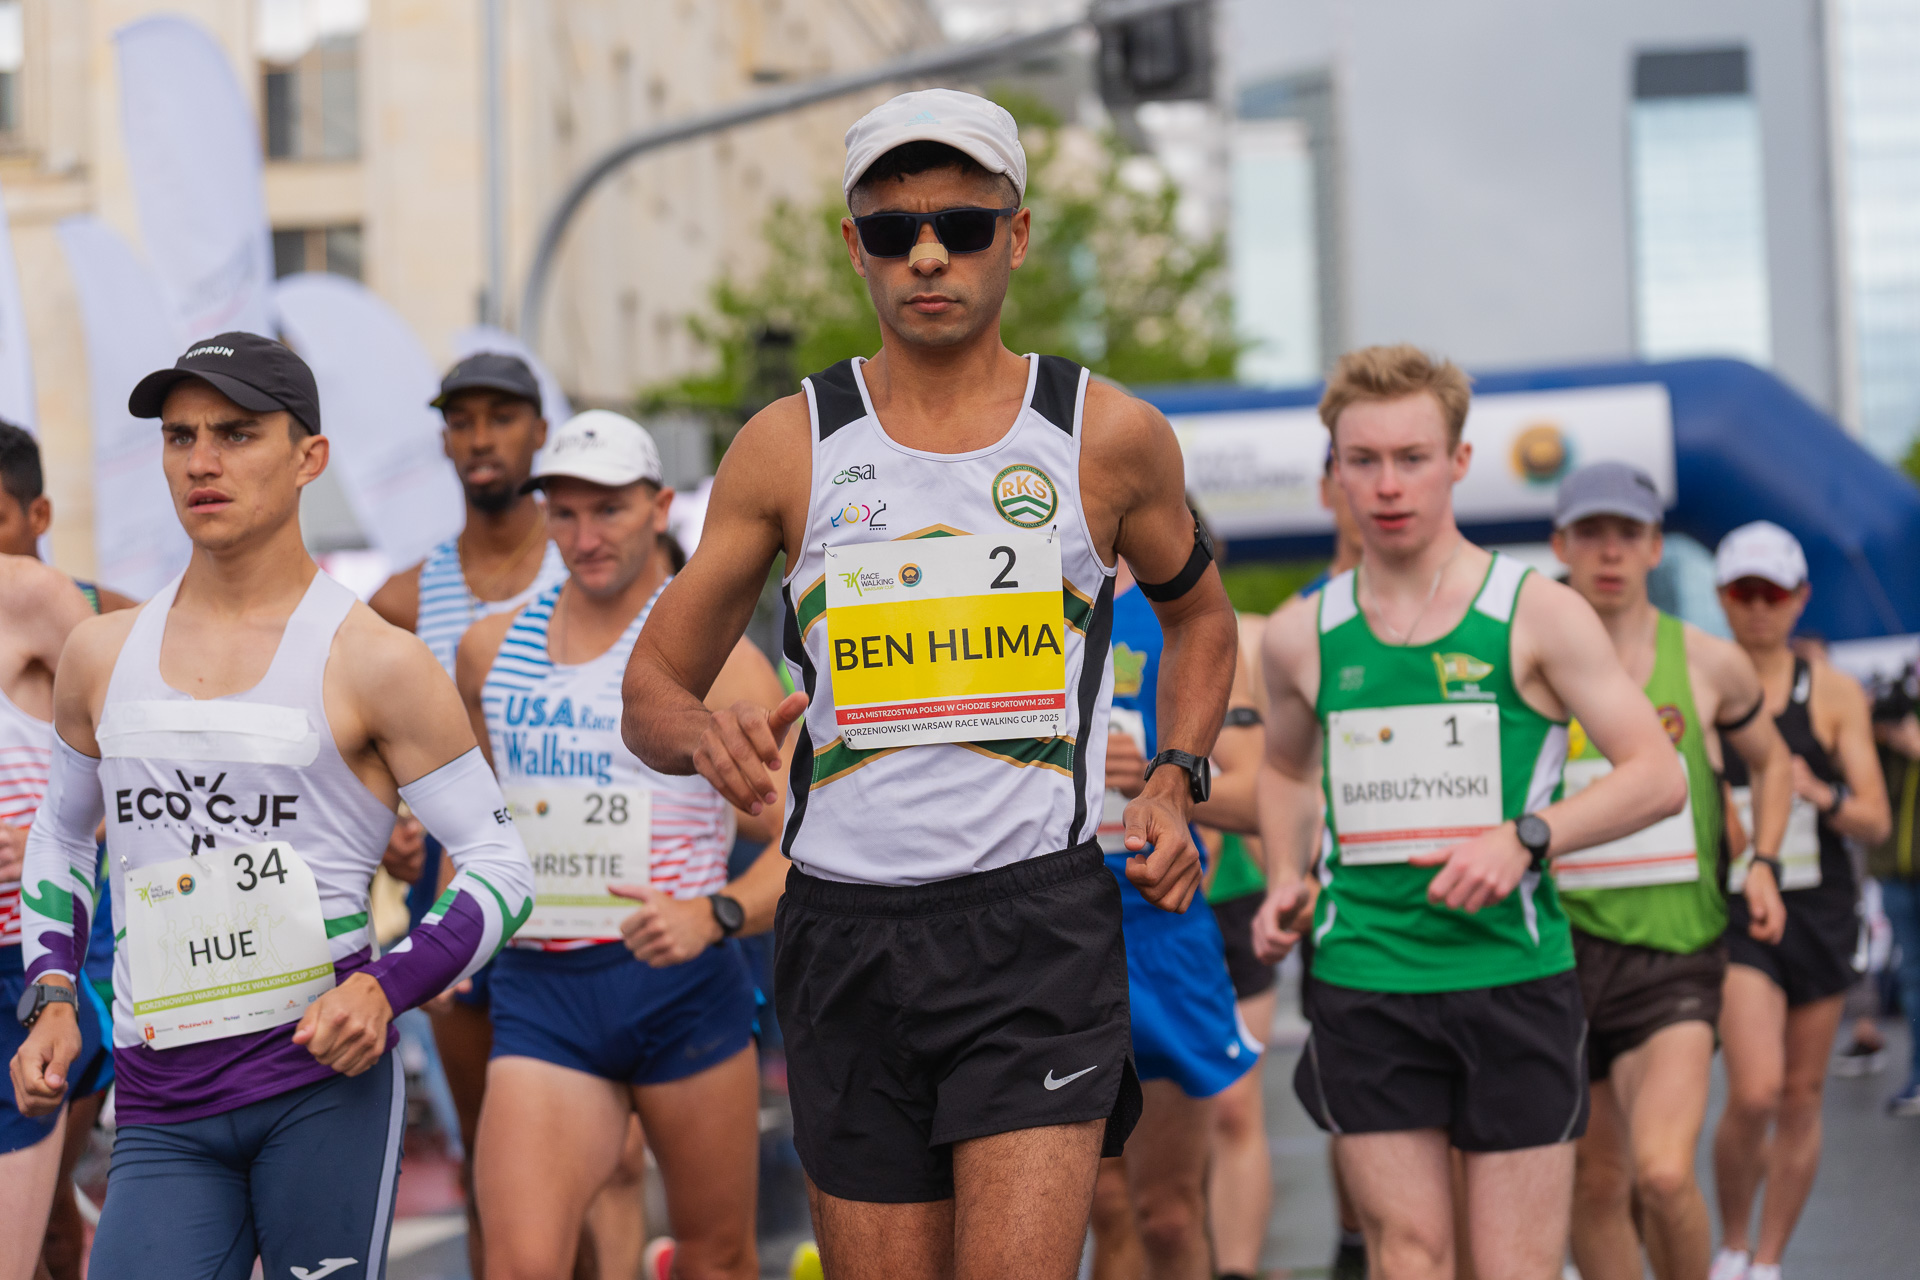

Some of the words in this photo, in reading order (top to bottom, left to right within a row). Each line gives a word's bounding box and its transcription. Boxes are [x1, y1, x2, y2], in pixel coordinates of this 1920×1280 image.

[185, 346, 235, 360] KIPRUN
[1002, 475, 1047, 499] RKS
[860, 572, 880, 581] RACE
[860, 578, 895, 587] WALKING
[988, 545, 1019, 589] 2
[834, 632, 915, 672] BEN
[928, 623, 1062, 663] HLIMA
[505, 695, 575, 728] USA
[844, 723, 910, 737] KORZENIOWSKI
[911, 720, 953, 731] WARSAW
[955, 718, 979, 728] RACE
[980, 715, 1020, 726] WALKING
[1020, 714, 1038, 724] CUP
[1039, 713, 1060, 722] 2025
[847, 711, 865, 720] PZLA
[865, 706, 919, 719] MISTRZOSTWA
[919, 704, 945, 714] POLSKI
[946, 703, 955, 711] W
[956, 701, 991, 711] CHODZIE
[991, 698, 1037, 708] SPORTOWYM
[1037, 697, 1055, 706] 2025
[1443, 714, 1463, 748] 1
[503, 731, 613, 787] Walking
[116, 787, 192, 824] ECO
[205, 793, 300, 828] CJF
[584, 792, 629, 825] 28
[233, 847, 288, 892] 34
[531, 853, 623, 878] HRISTIE
[189, 929, 257, 967] HUE
[138, 993, 193, 1011] KORZENIOWSKI
[193, 987, 231, 1001] WARSAW
[231, 983, 251, 994] RACE
[251, 975, 291, 991] WALKING
[291, 971, 309, 982] CUP
[309, 966, 329, 978] 2025
